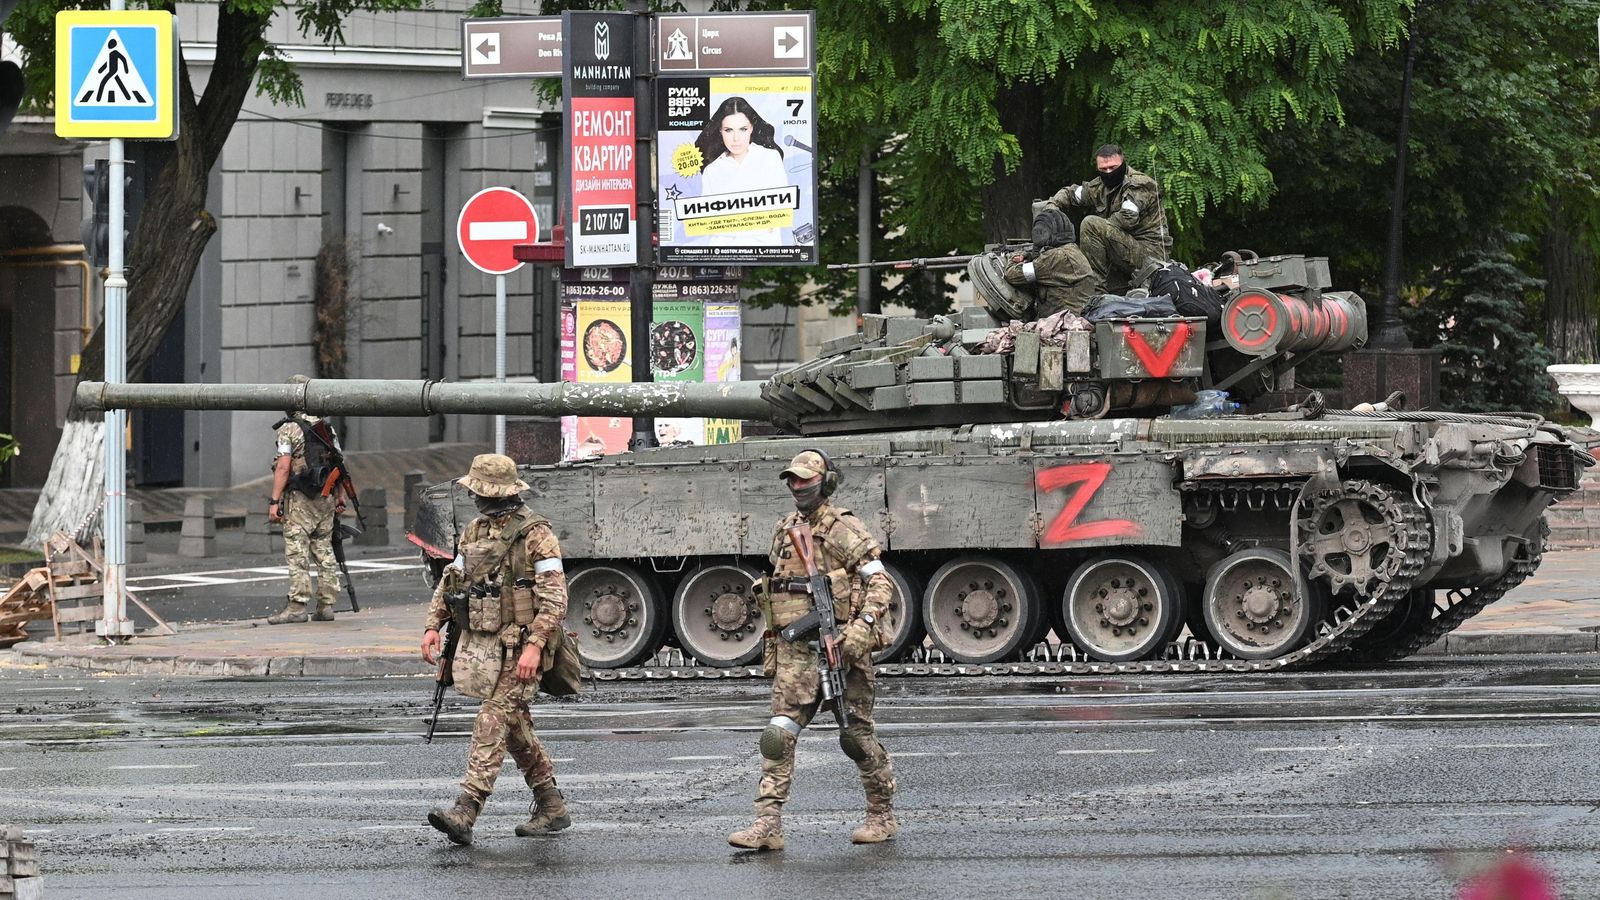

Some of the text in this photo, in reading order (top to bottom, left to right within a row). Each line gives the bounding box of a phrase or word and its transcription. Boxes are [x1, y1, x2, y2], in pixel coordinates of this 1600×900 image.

[538, 32, 556, 41] Река
[702, 29, 719, 39] Цирк
[538, 48, 563, 57] Don Riv
[702, 46, 722, 55] Circus
[574, 66, 631, 79] MANHATTAN
[668, 87, 699, 97] РУКИ
[668, 97, 706, 107] ВВЕРХ
[786, 99, 804, 117] 7
[668, 107, 692, 117] БАР
[574, 110, 632, 137] РЕМОНТ
[574, 145, 633, 172] КВАРТИР
[677, 158, 699, 170] 20:00
[576, 176, 632, 193] ДИЗАЙН ИНТЕРЬЕРА
[683, 192, 792, 215] ИНФИНИТИ
[585, 212, 624, 231] 2 107 167
[579, 243, 631, 255] SK-MANHATTAN.RU
[583, 267, 610, 279] 40/2
[659, 266, 690, 279] 40/1
[710, 284, 738, 294] 226-26-0
[1121, 321, 1190, 378] V
[1036, 462, 1145, 544] Z
